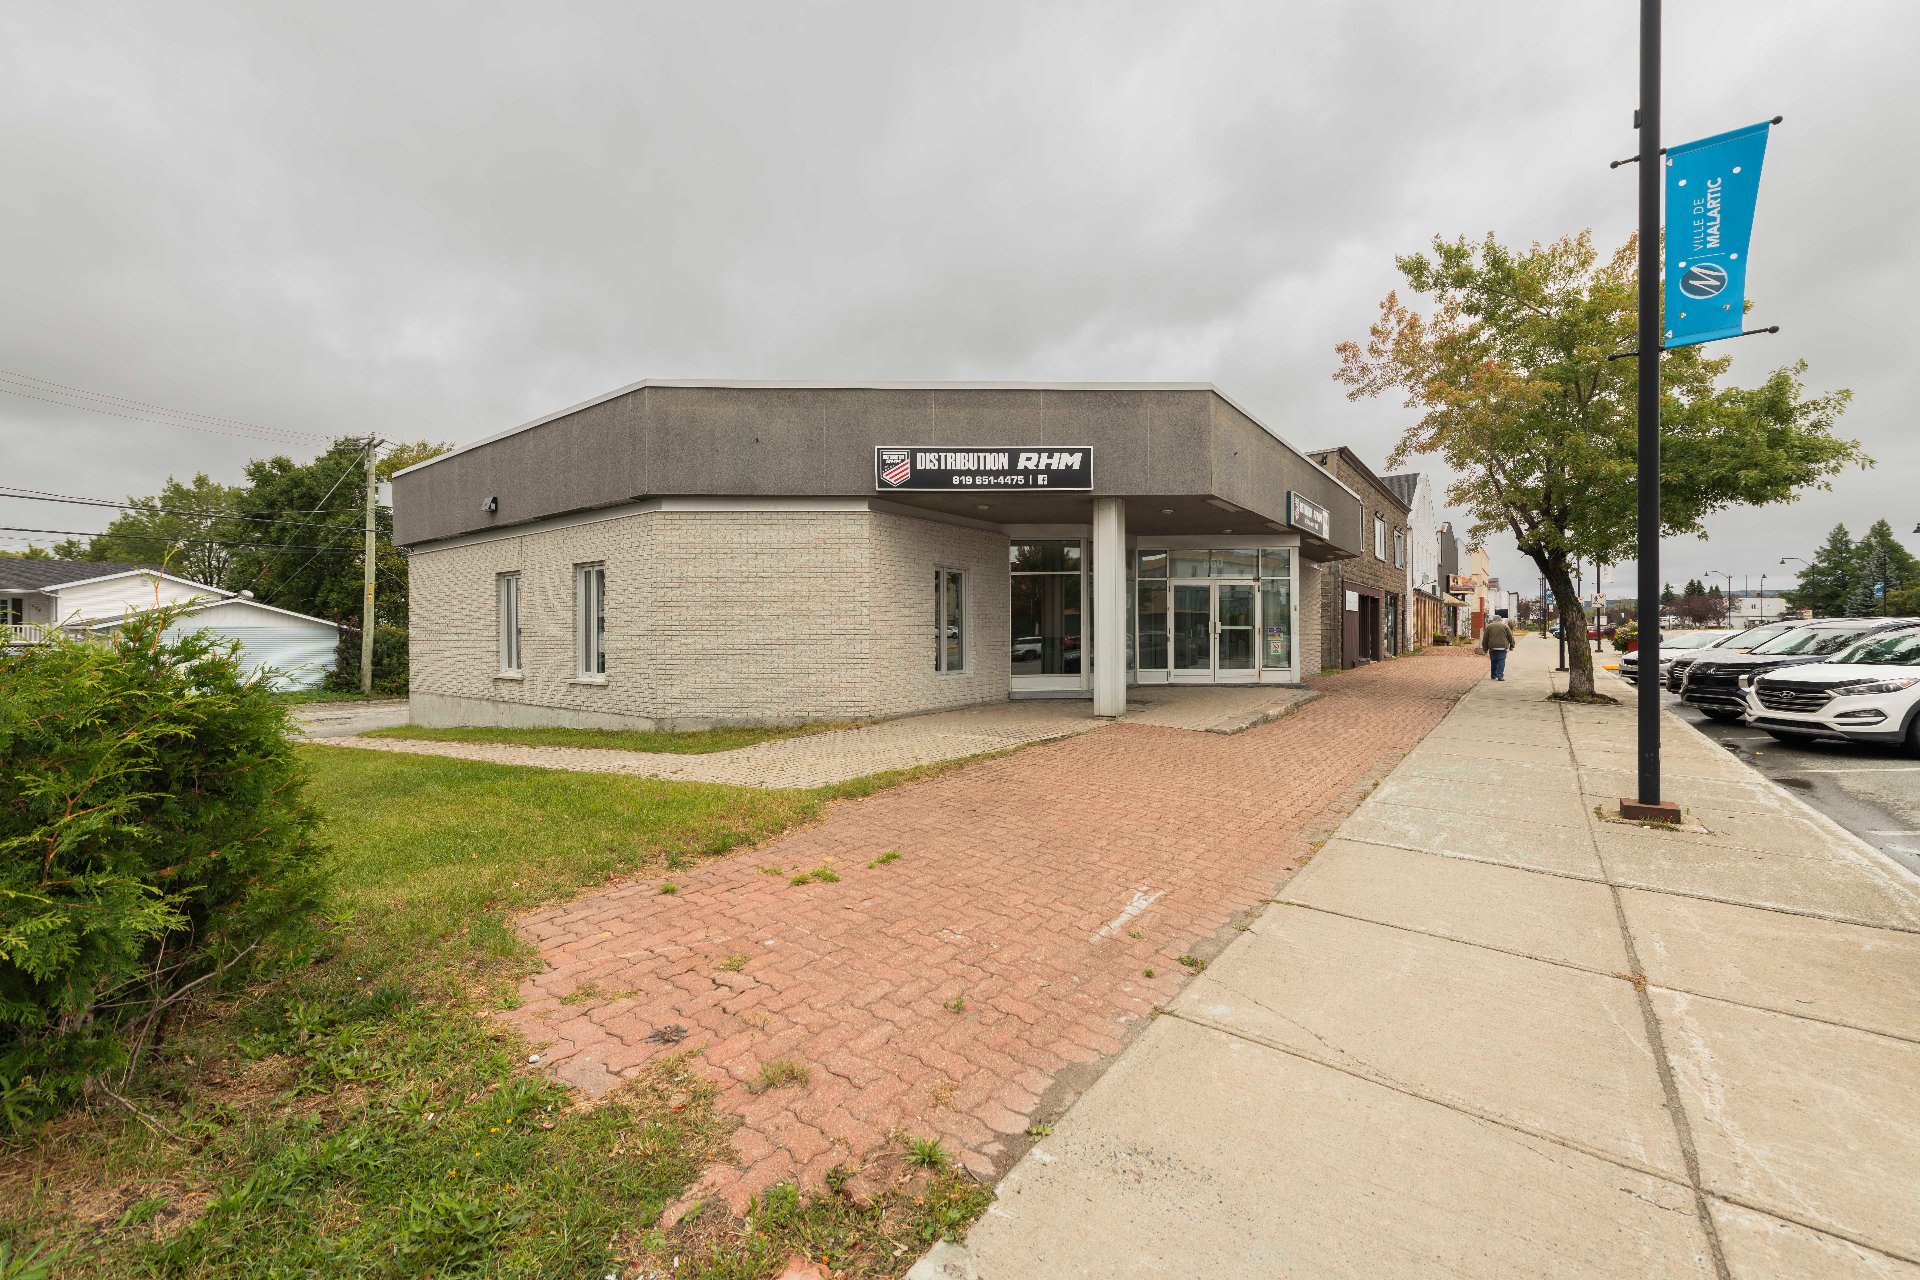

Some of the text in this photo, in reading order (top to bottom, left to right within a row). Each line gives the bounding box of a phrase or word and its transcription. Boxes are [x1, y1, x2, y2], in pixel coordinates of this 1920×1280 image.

[1692, 198, 1705, 252] VILLE DE
[1706, 177, 1722, 249] MALARTIC
[916, 452, 1009, 470] DISTRIBUTION
[1017, 452, 1083, 470] RHM
[952, 475, 973, 485] 819
[975, 475, 1025, 485] 651-4475
